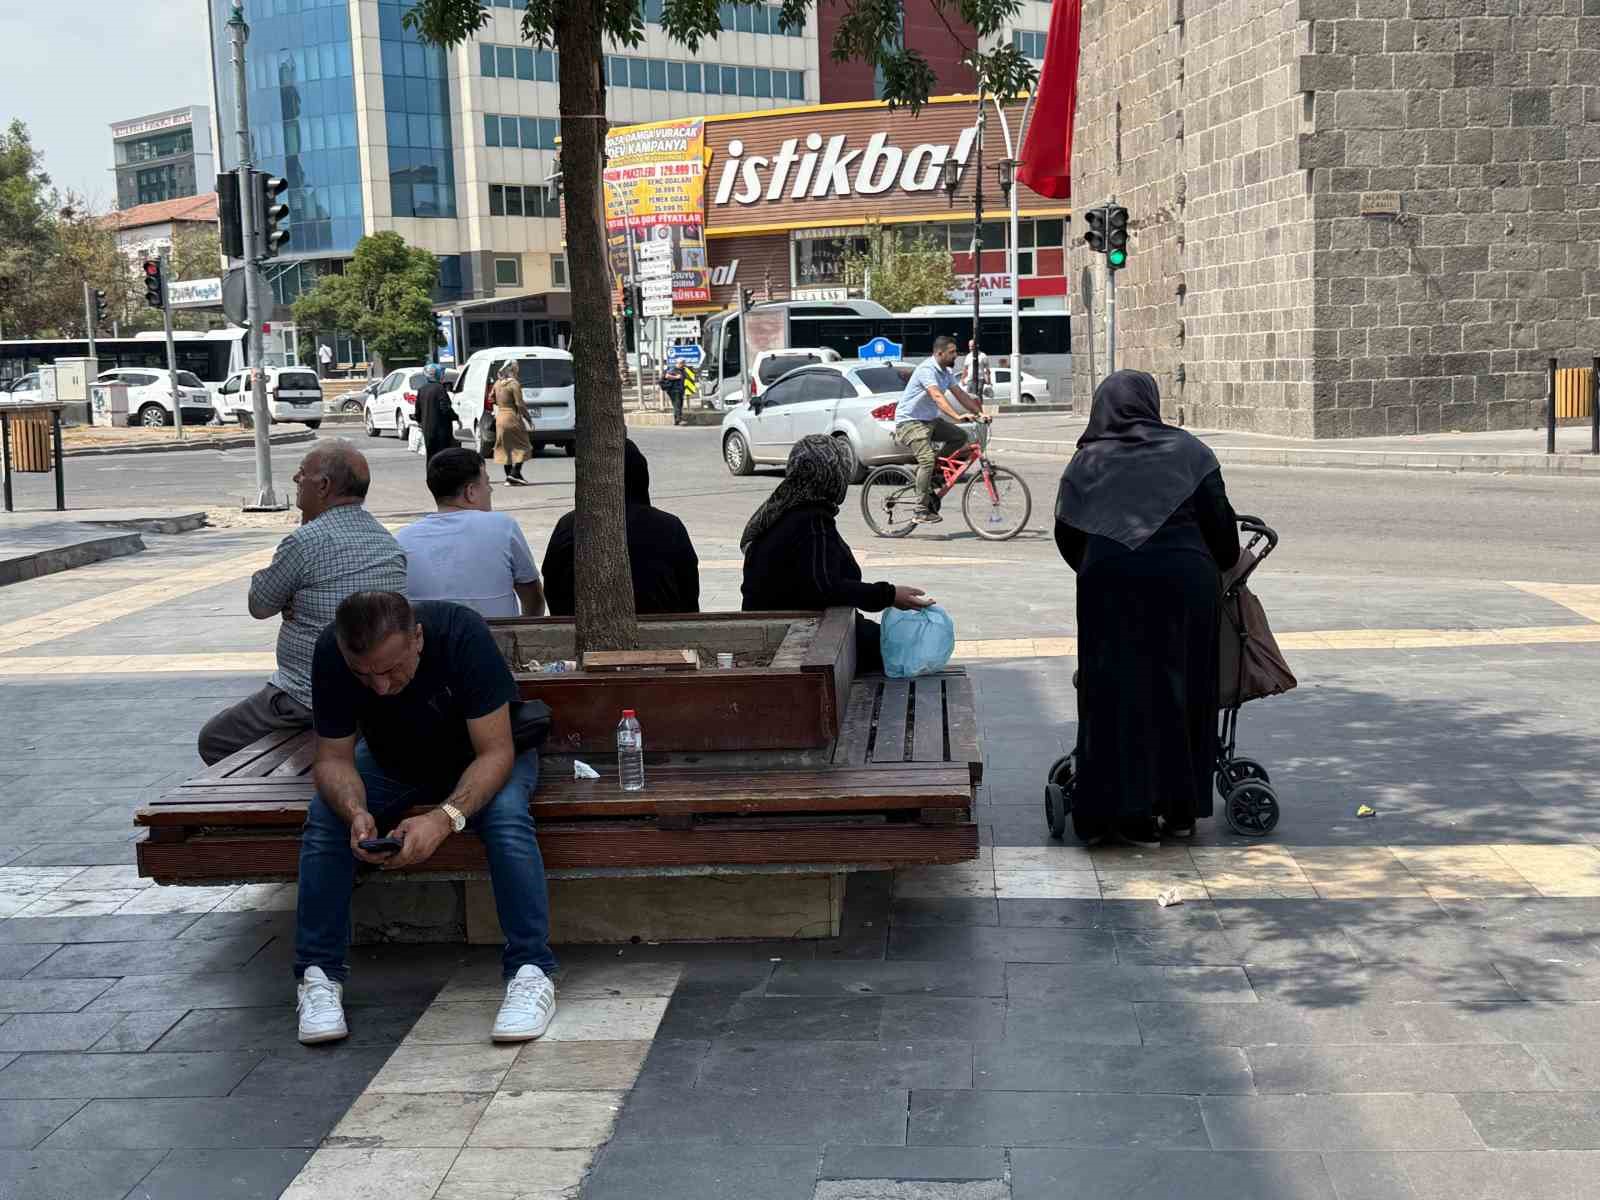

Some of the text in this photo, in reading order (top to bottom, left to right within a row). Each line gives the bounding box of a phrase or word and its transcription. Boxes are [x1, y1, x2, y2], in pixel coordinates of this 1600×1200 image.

[655, 127, 698, 138] VURACAK
[628, 138, 688, 154] KAMPANYA
[714, 127, 979, 205] istikbal
